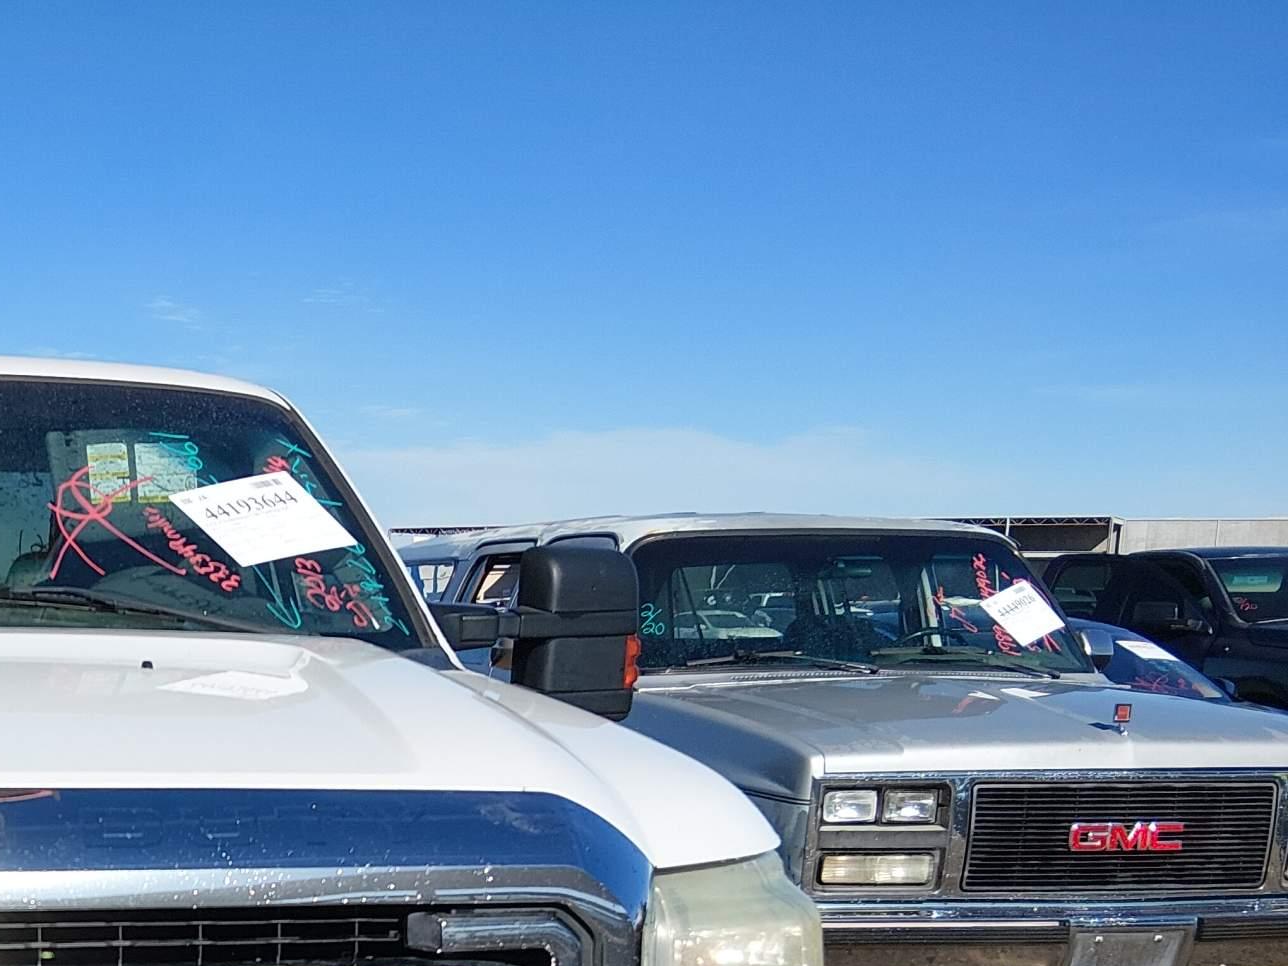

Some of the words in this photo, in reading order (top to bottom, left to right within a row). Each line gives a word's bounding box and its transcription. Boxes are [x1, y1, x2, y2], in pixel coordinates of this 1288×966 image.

[205, 491, 298, 519] 44193644
[640, 603, 665, 635] 2/20
[1069, 822, 1184, 852] GMC
